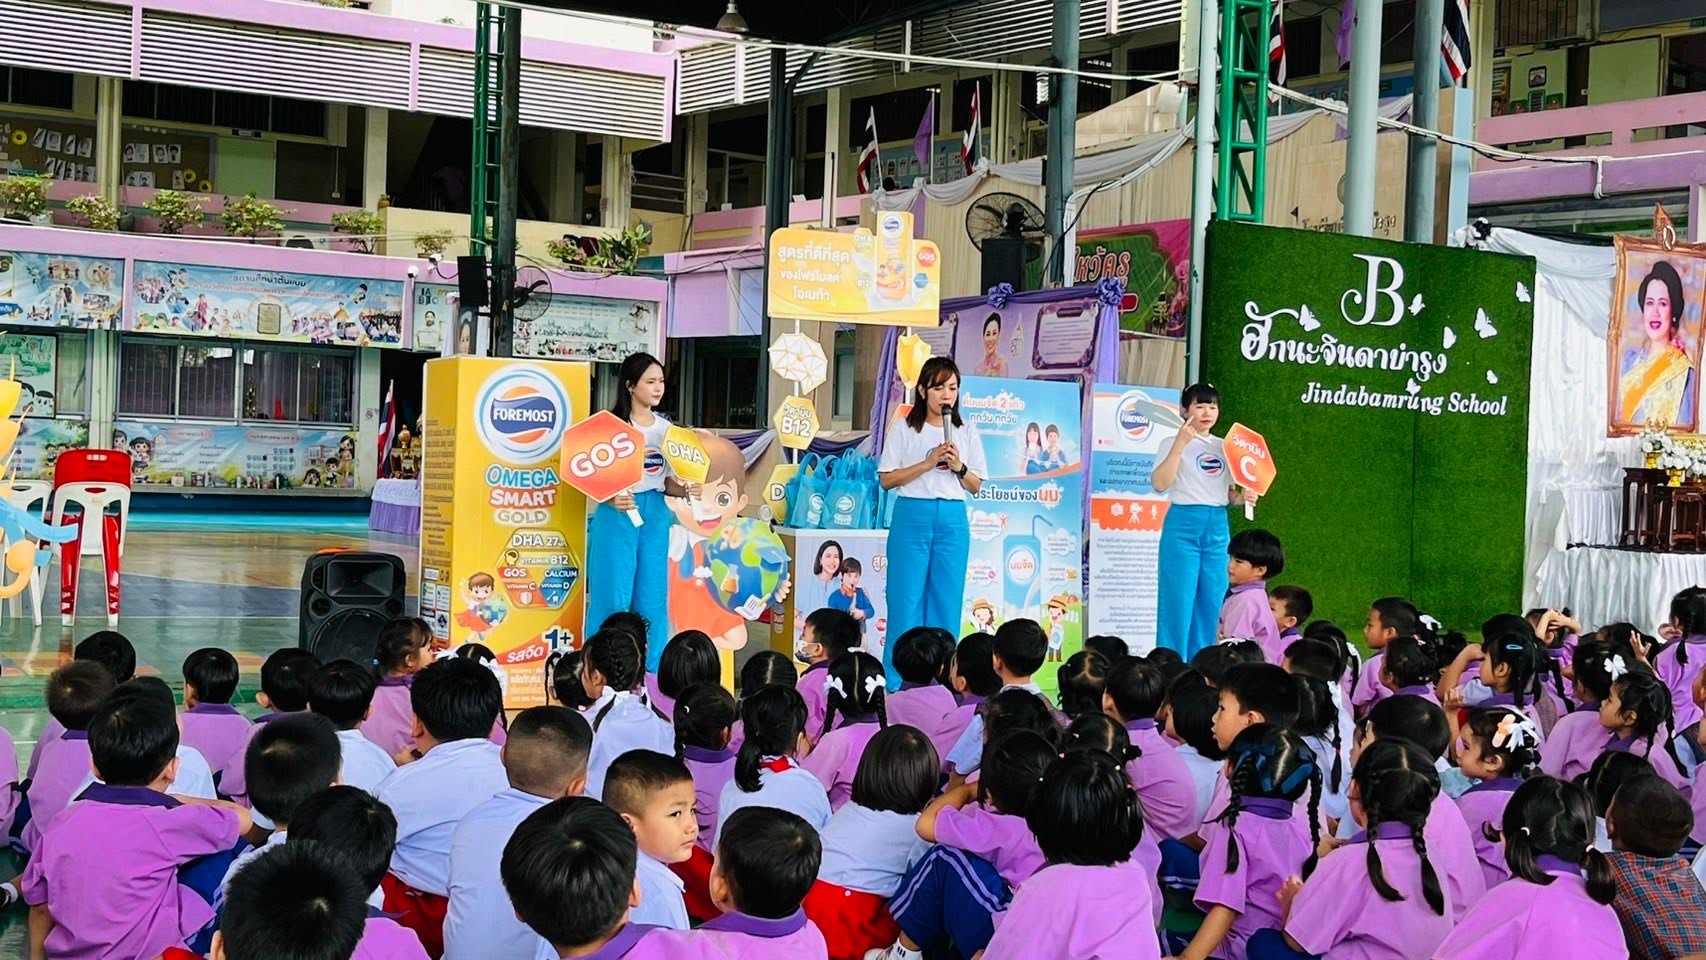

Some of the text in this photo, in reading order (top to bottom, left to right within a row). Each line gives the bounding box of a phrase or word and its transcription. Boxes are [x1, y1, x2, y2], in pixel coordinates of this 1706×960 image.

[1301, 382, 1508, 416] Jindabamrung School
[493, 406, 555, 423] FOREMOST
[781, 417, 810, 437] B12
[569, 431, 637, 478] GOS
[667, 440, 706, 465] DHA
[487, 465, 560, 487] OMEGA
[1240, 455, 1257, 482] C
[490, 489, 557, 506] SMART
[770, 483, 786, 501] D
[497, 509, 548, 524] GOLD
[512, 534, 544, 547] DHA
[550, 555, 569, 565] B12
[503, 568, 527, 577] GOS
[544, 569, 578, 578] CALCIUM
[507, 644, 545, 663] รสจืด
